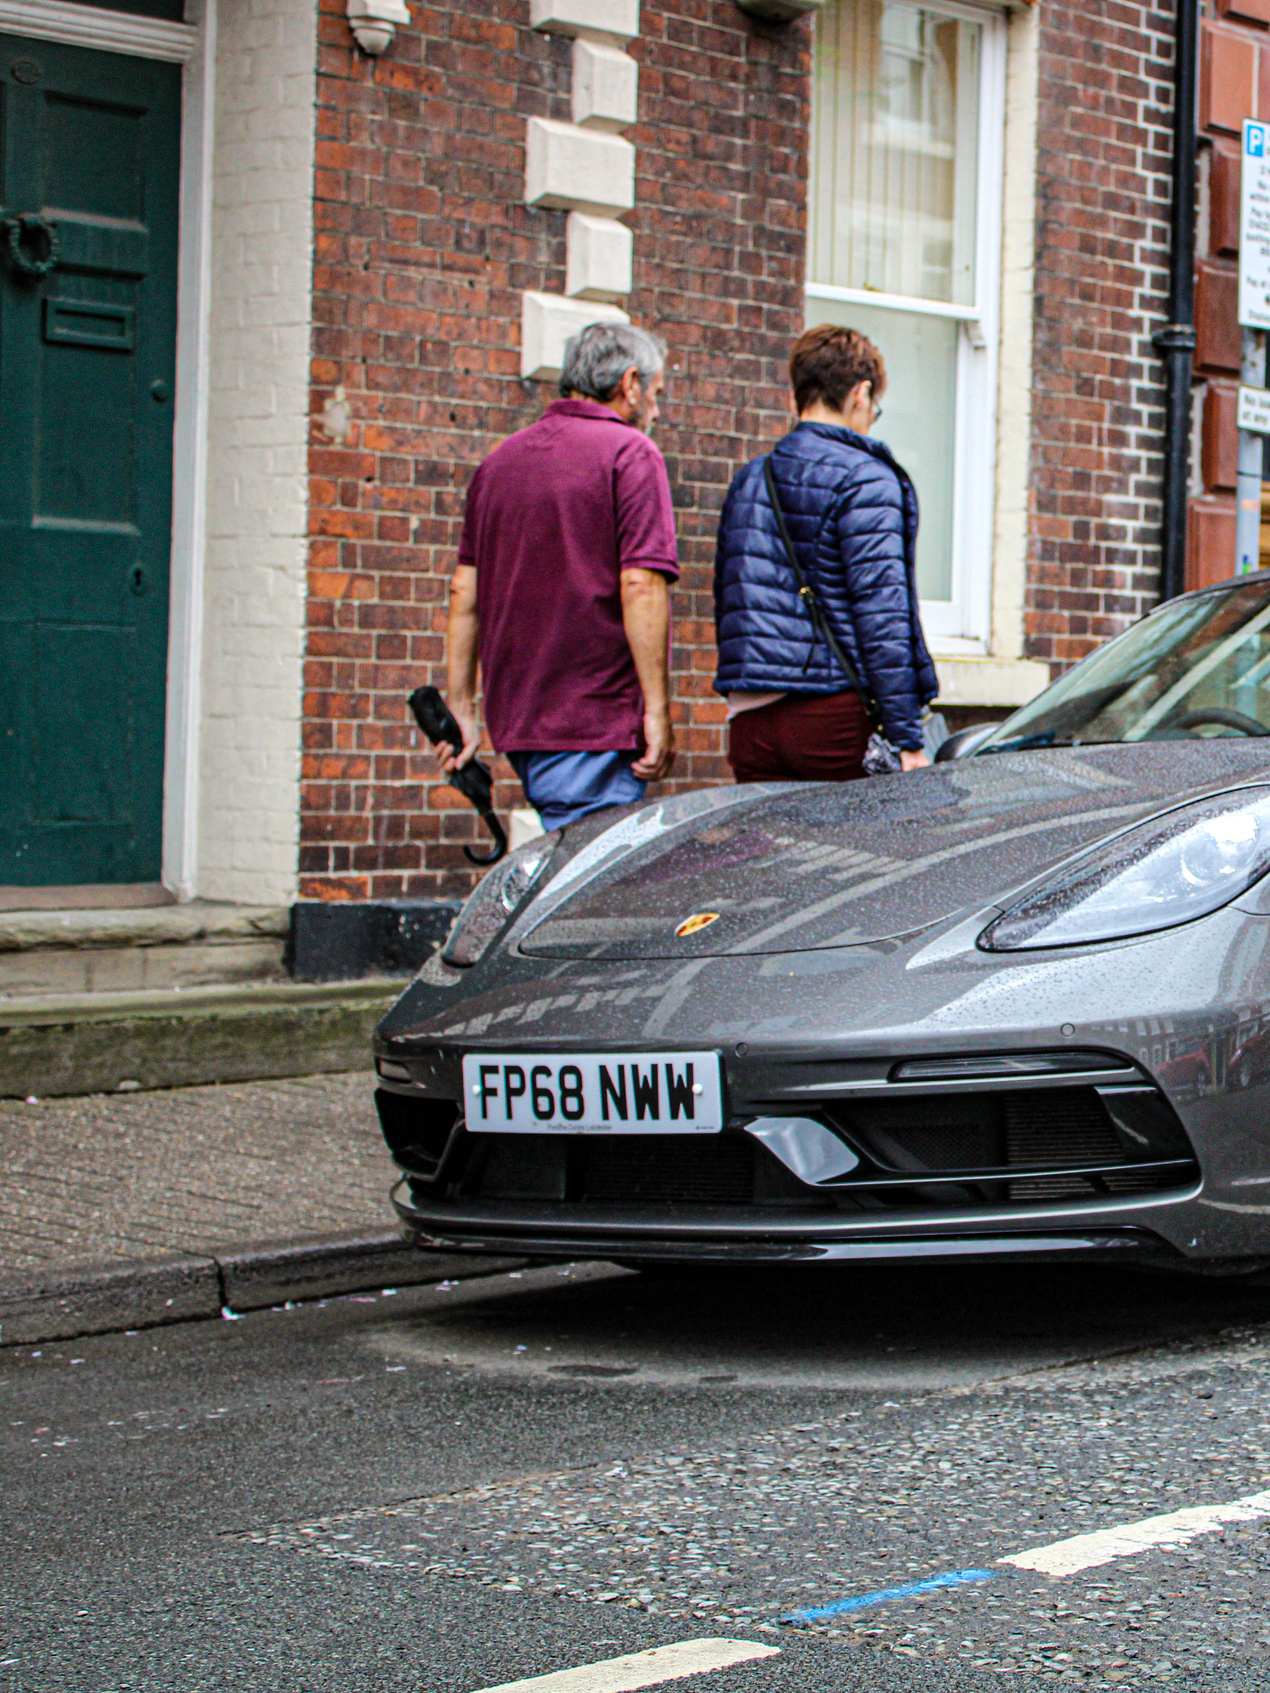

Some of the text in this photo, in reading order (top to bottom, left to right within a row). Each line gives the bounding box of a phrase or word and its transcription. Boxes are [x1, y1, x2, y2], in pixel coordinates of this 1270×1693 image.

[1250, 193, 1270, 203] within
[1244, 393, 1256, 406] No
[1242, 410, 1251, 420] at
[1254, 414, 1268, 426] any
[479, 1062, 696, 1121] FP68 NWW
